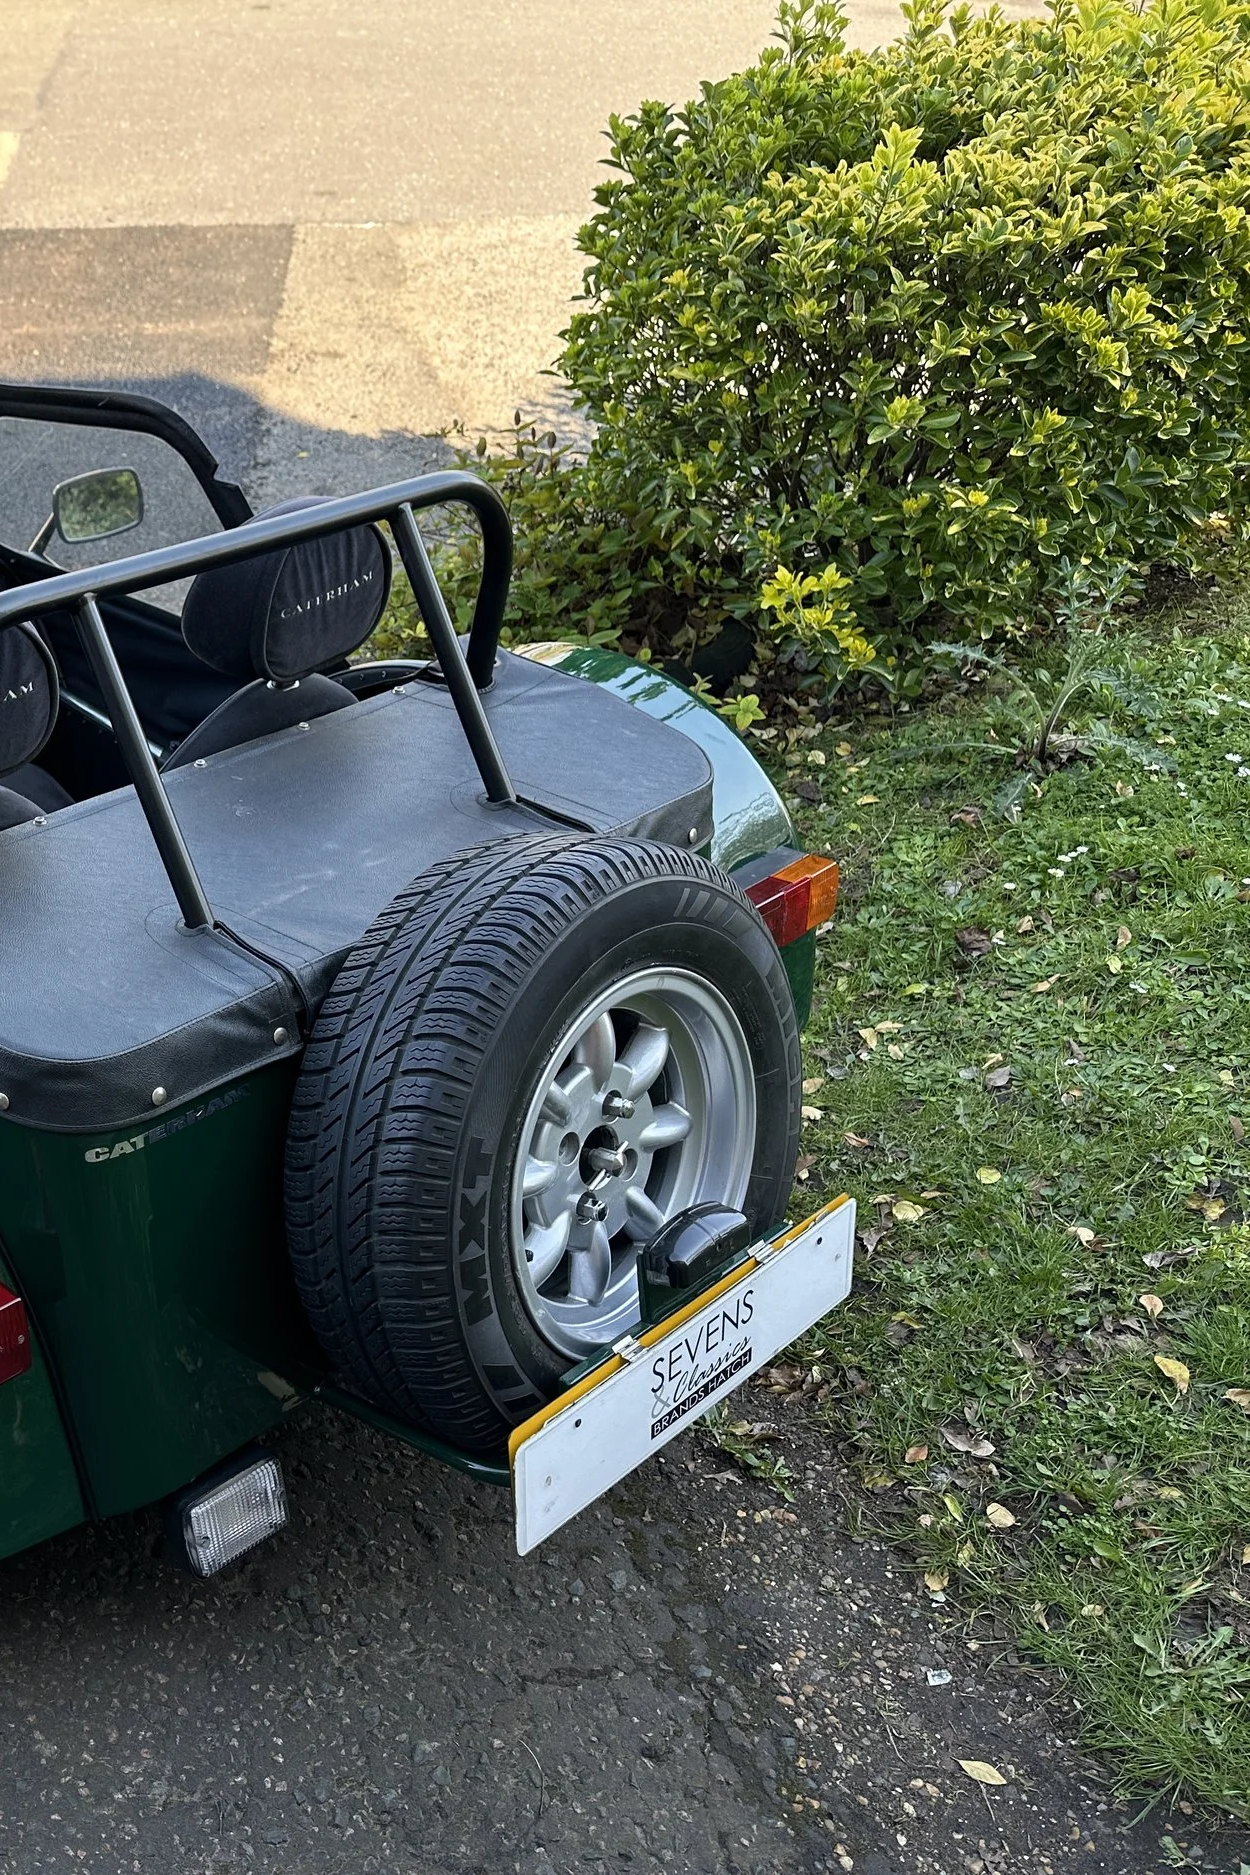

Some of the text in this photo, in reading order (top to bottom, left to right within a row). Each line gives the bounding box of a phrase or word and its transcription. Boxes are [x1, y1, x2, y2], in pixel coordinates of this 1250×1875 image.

[280, 570, 373, 618] CATERHAM
[84, 1083, 252, 1163] CATERHAM
[651, 1289, 754, 1393] SEVENS
[673, 1336, 752, 1403] Classics
[653, 1351, 751, 1436] BRANDS HATCH
